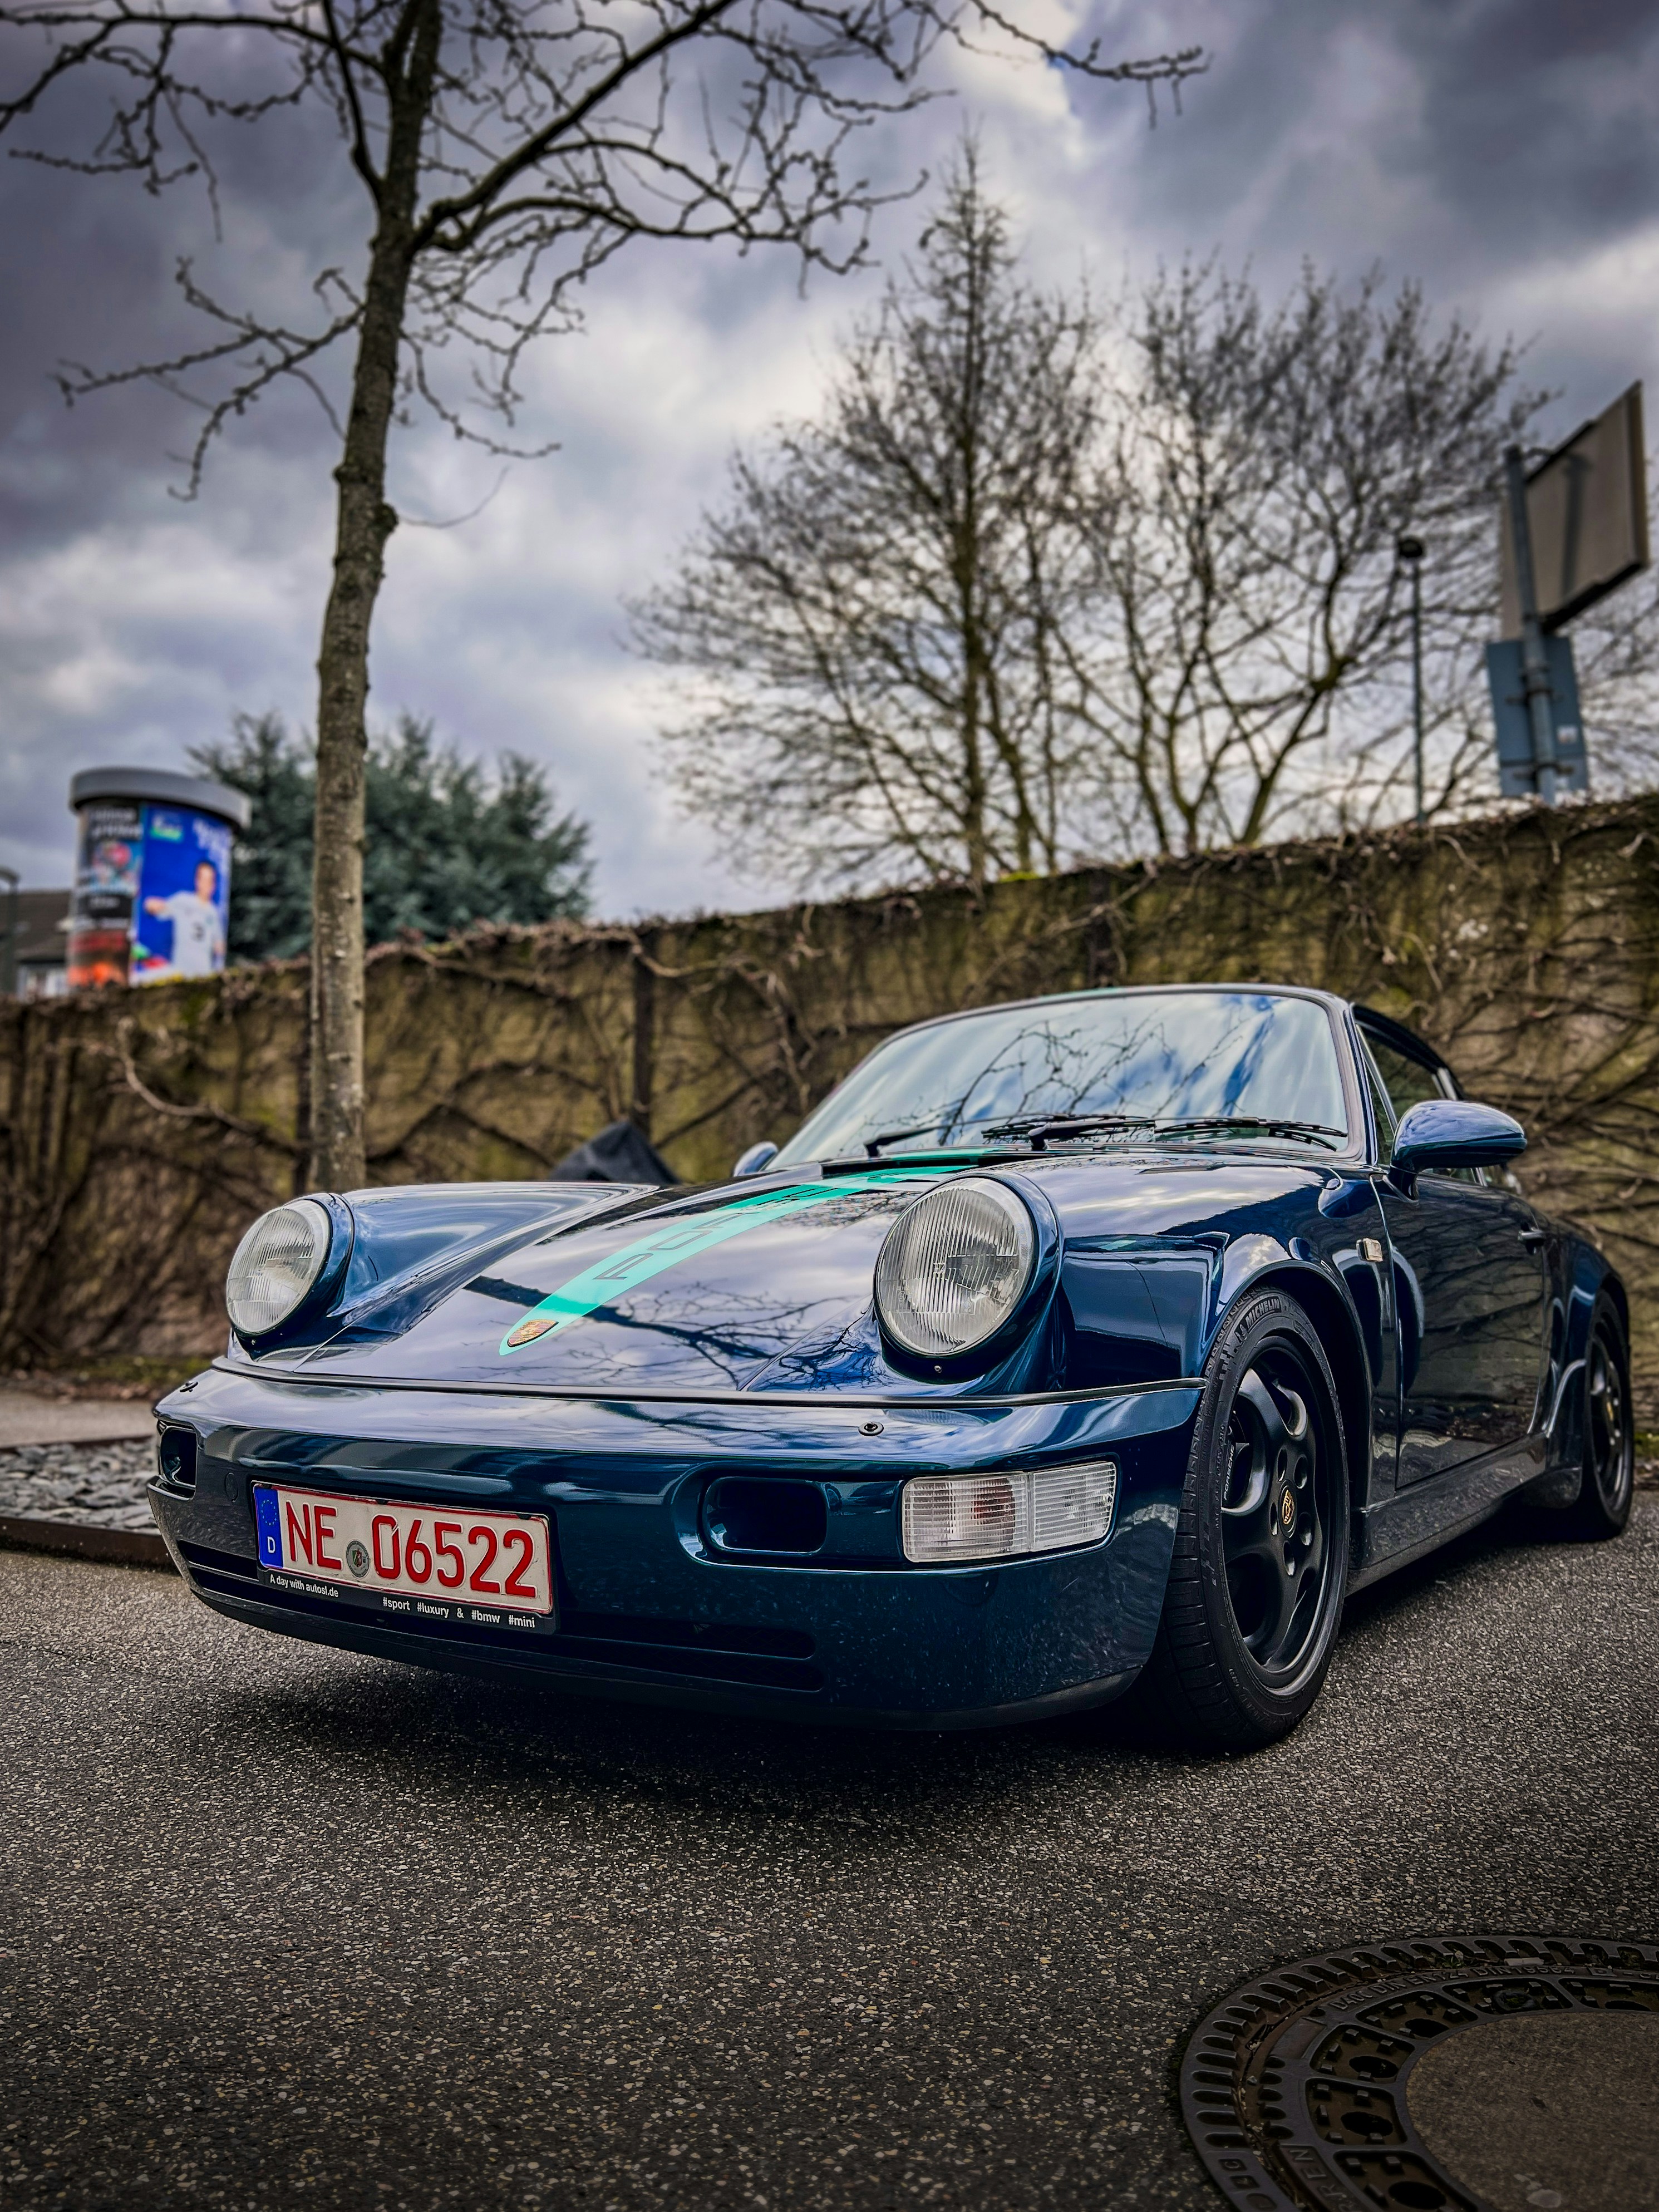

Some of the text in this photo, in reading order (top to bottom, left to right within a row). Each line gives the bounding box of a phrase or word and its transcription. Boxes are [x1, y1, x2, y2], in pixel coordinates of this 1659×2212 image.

[1244, 1298, 1281, 1329] MICHELIN
[1223, 1444, 1235, 1501] PORSCHE
[267, 1536, 276, 1553] D
[285, 1500, 343, 1570] NE
[371, 1514, 536, 1598] 06522
[269, 1573, 339, 1598] A day with autosl.de
[382, 1597, 535, 1628] #sport #luxury & #bmw #mini
[1369, 1981, 1407, 1994] DIN
